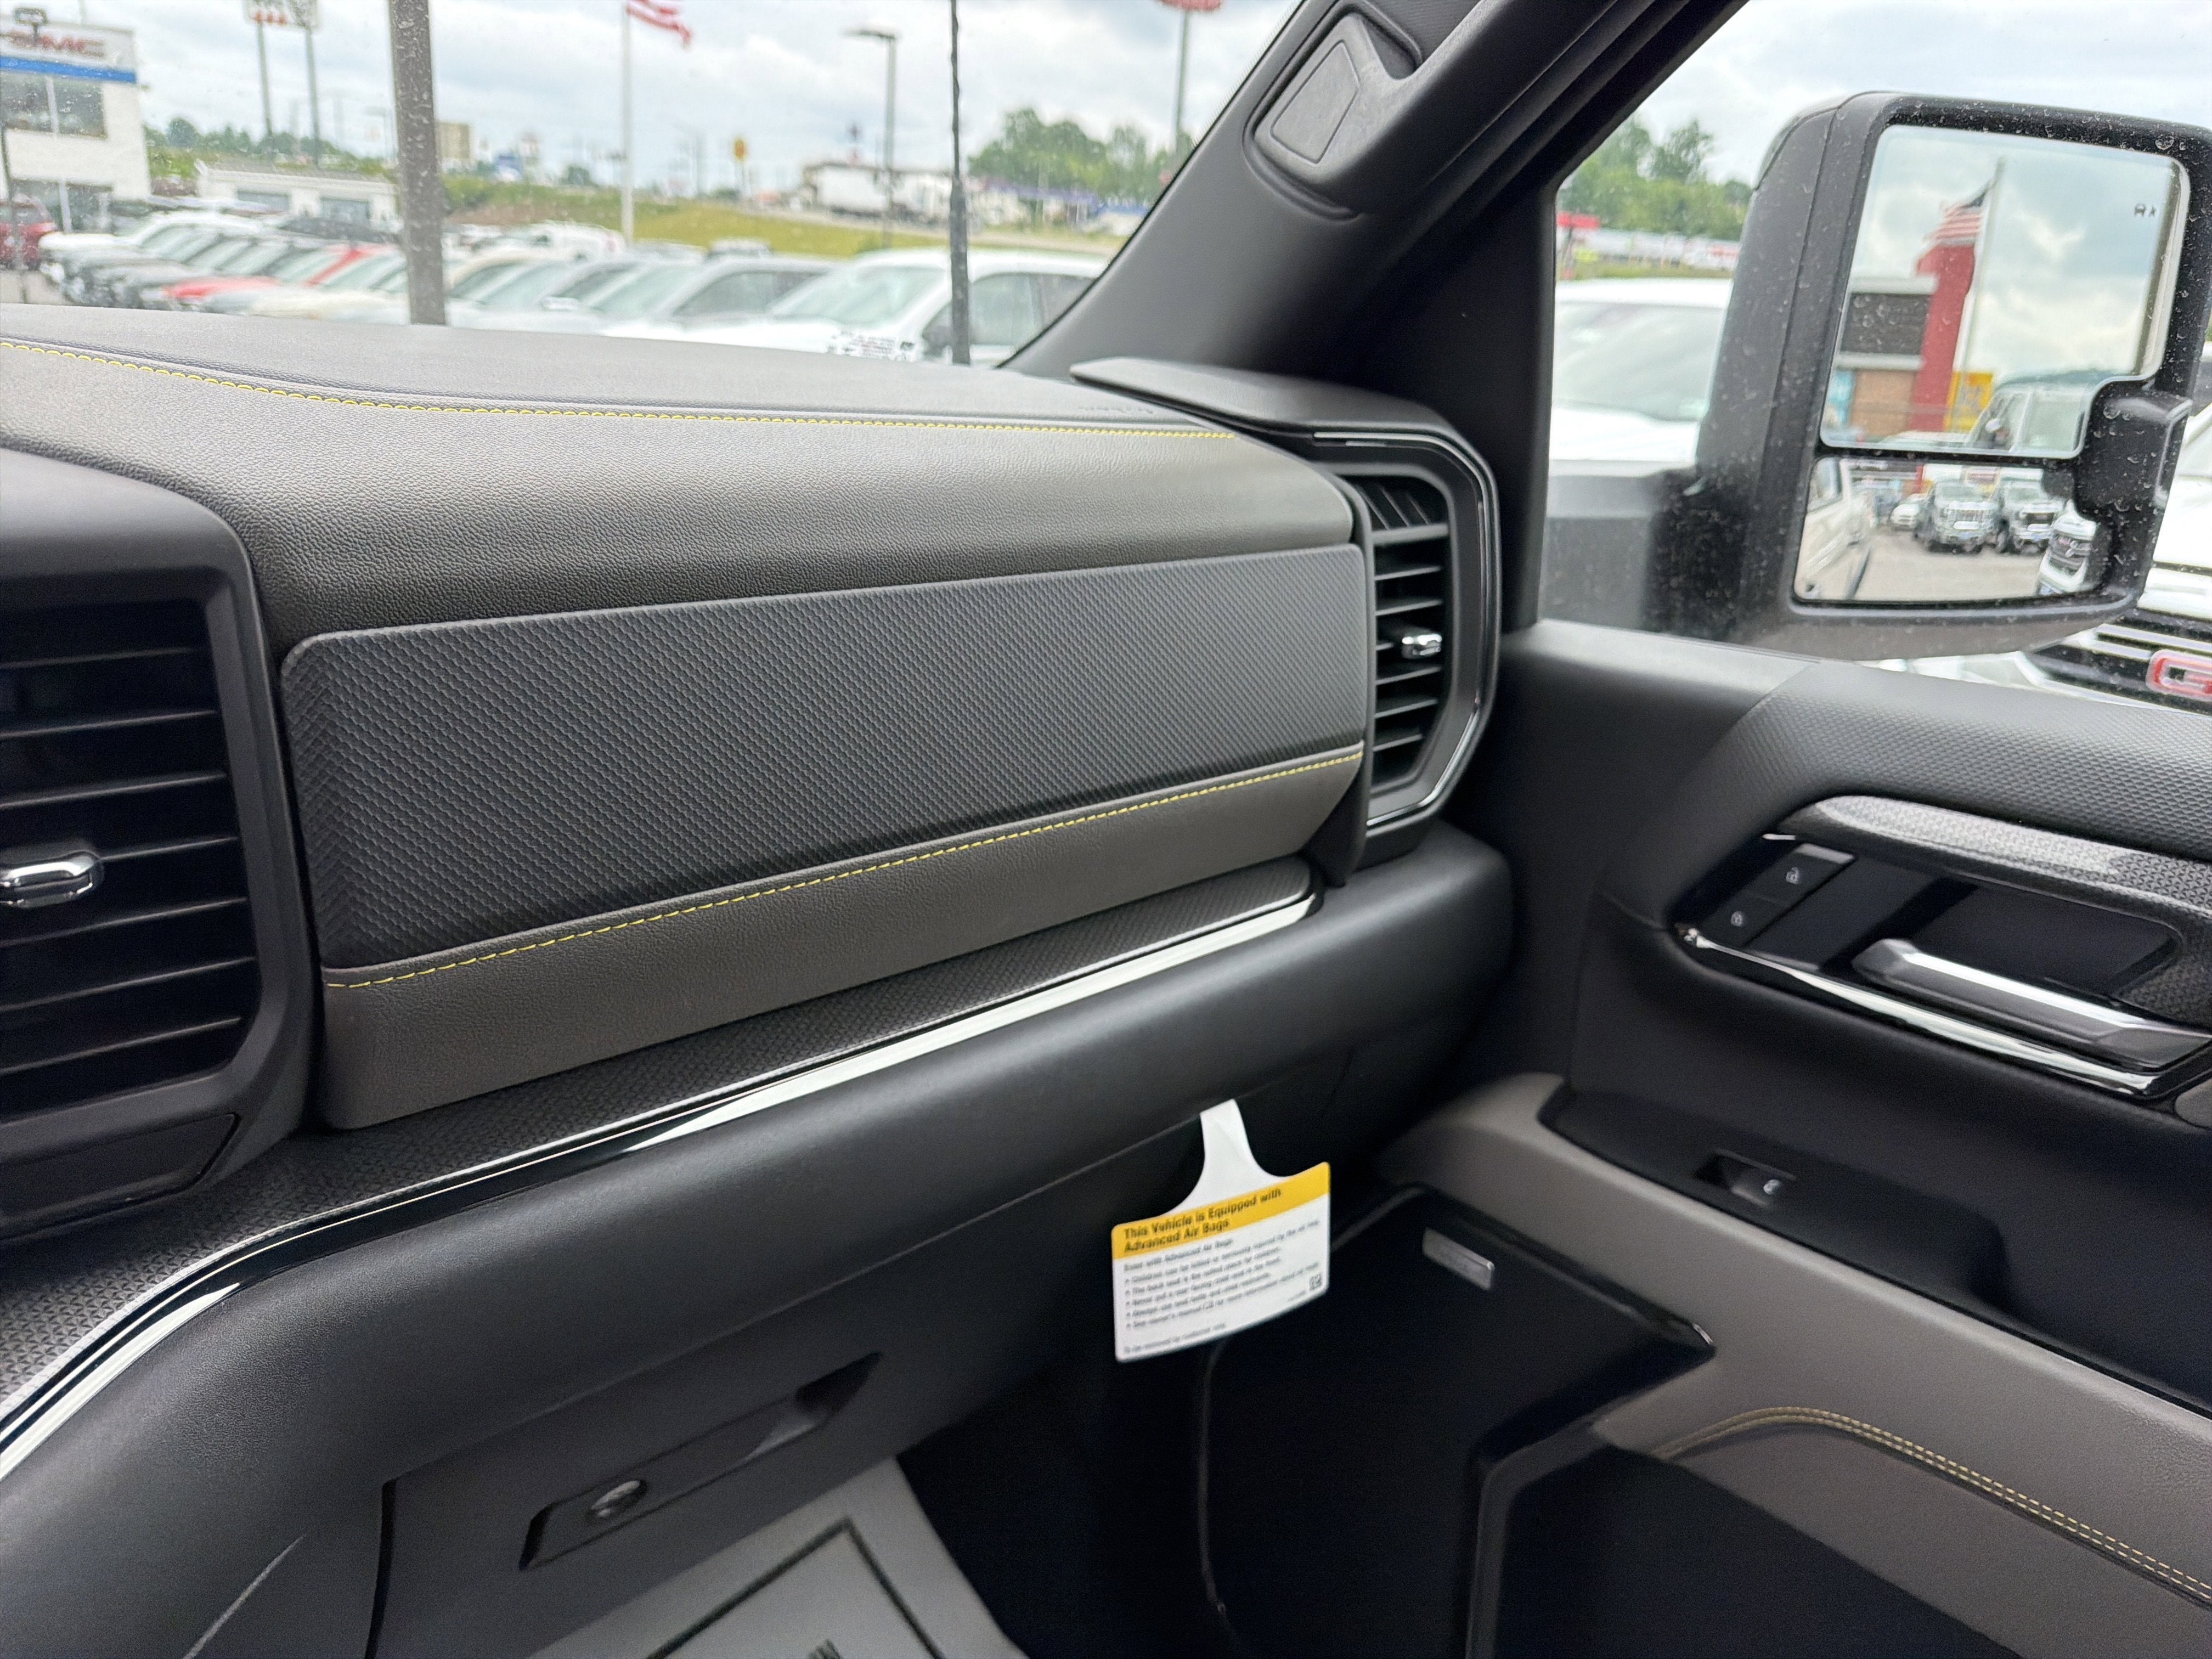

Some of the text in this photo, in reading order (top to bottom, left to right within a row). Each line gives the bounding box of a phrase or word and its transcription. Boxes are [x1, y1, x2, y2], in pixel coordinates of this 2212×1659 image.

[1125, 1188, 1282, 1239] This Vehicle is Equipped with
[1125, 1218, 1229, 1252] Advanced Air Bags
